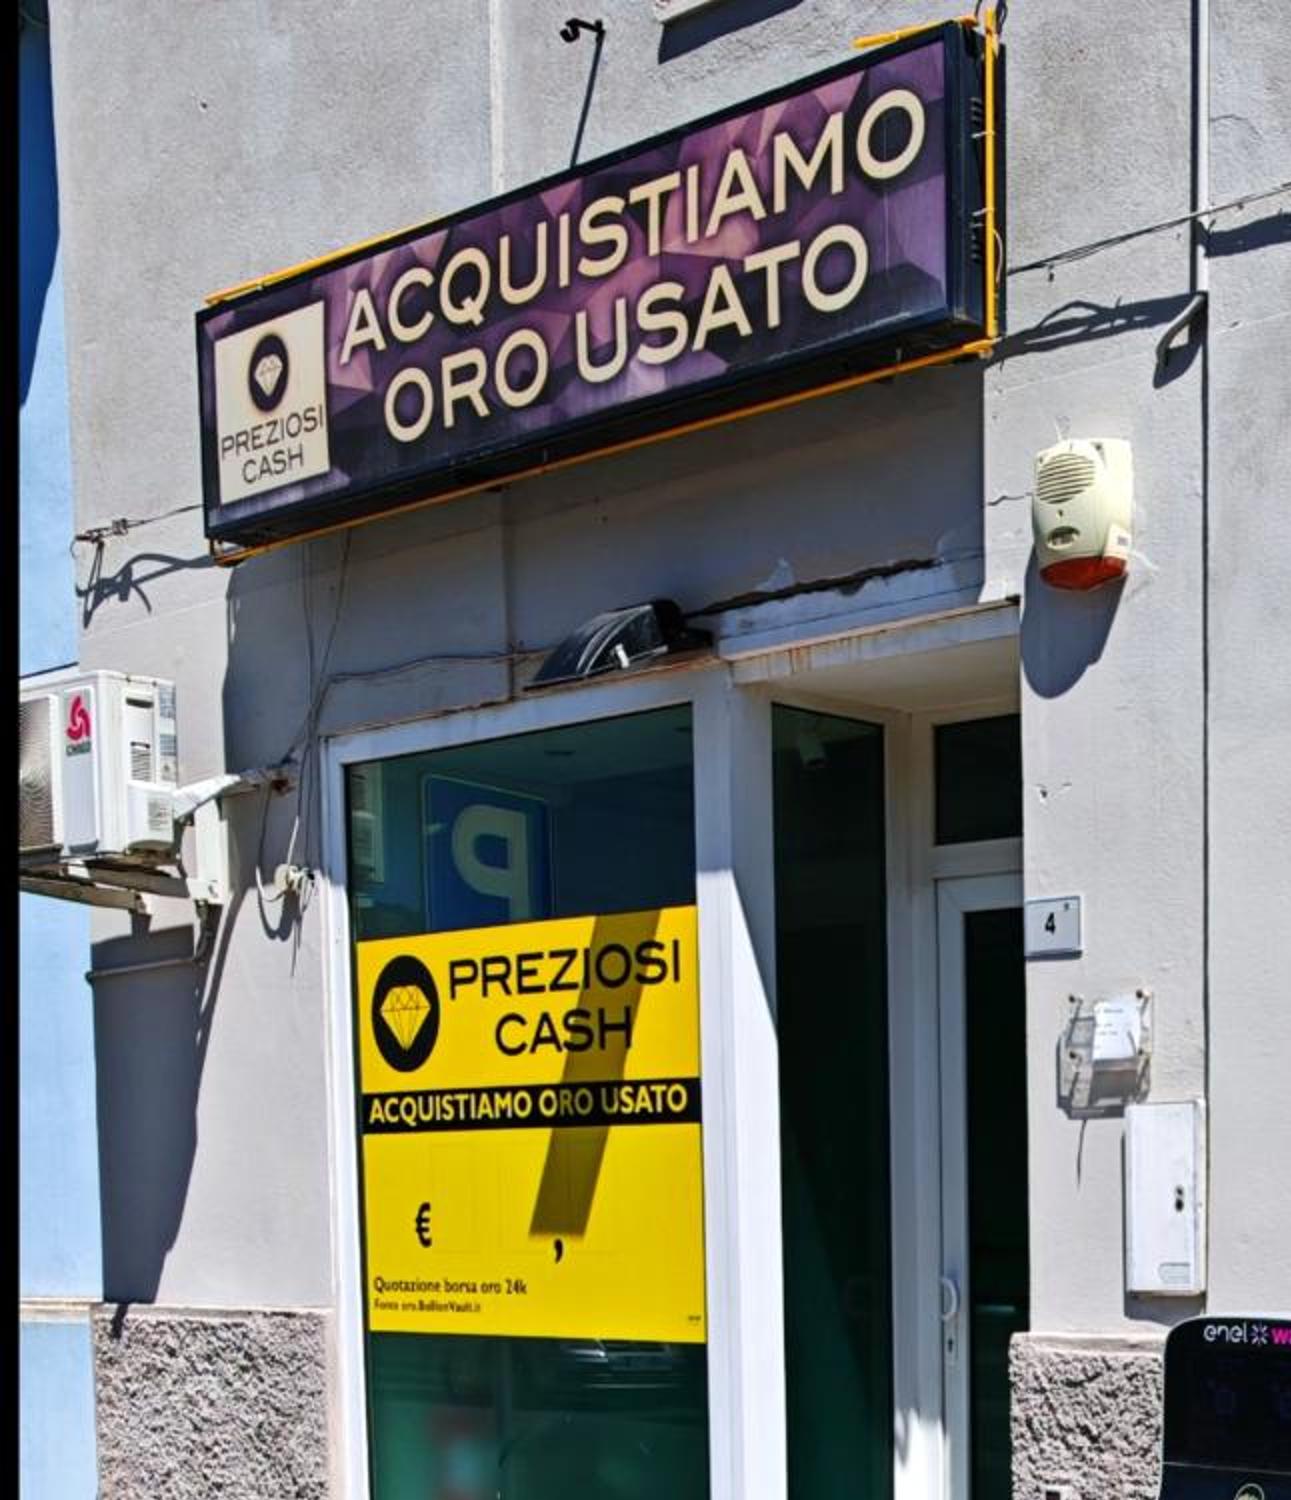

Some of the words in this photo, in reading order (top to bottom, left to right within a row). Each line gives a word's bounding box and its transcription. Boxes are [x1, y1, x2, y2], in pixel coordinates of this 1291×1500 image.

[340, 88, 925, 365] ACQUISTIAMO
[384, 328, 548, 442] ORO
[575, 224, 868, 384] USATO
[221, 403, 324, 460] PREZIOSI
[241, 443, 304, 484] CASH
[1044, 911, 1056, 934] 4
[448, 938, 681, 1001] PREZIOSI
[495, 1006, 633, 1057] CASH
[369, 1090, 533, 1127] ACQUISTIAMO
[538, 1087, 594, 1118] ORO
[601, 1083, 688, 1115] USATO
[374, 1276, 440, 1294] Quotazione
[443, 1278, 477, 1293] borsa
[480, 1282, 501, 1294] oro
[505, 1279, 527, 1295] 24k
[1203, 1322, 1248, 1344] enel
